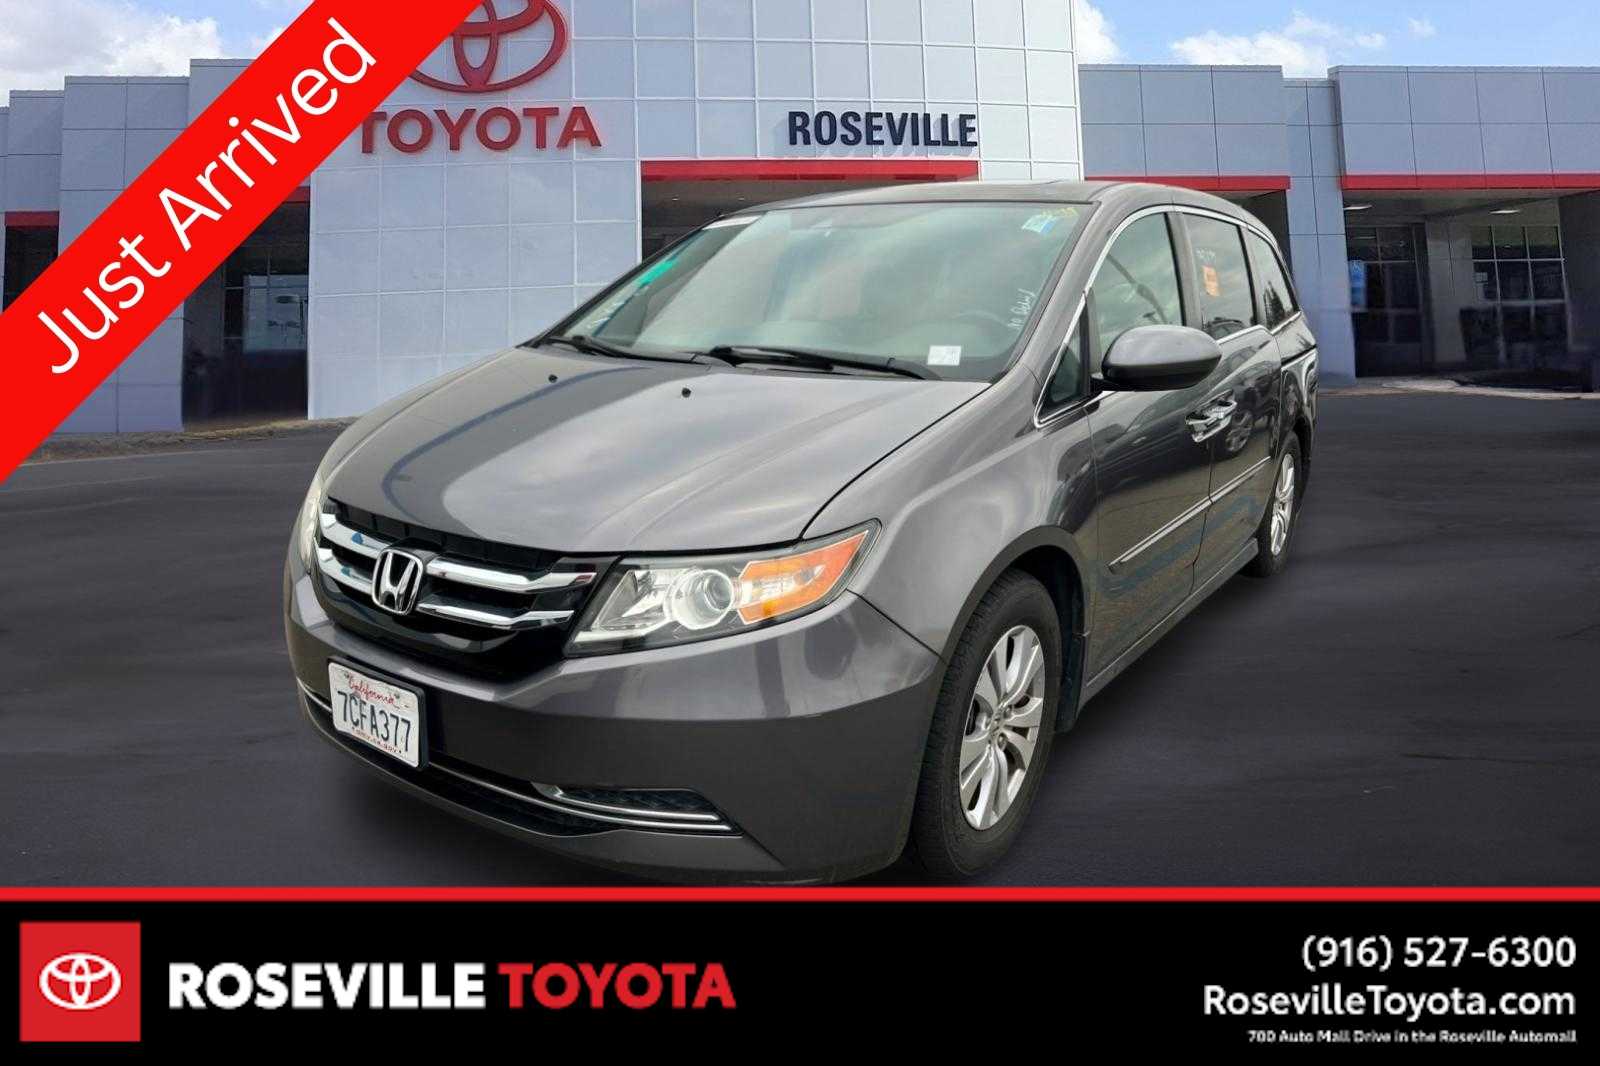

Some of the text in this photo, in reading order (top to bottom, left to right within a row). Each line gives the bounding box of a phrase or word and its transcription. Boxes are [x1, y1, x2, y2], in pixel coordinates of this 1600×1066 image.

[361, 106, 602, 154] TOYOTA
[788, 110, 978, 147] ROSEVILLE
[337, 690, 412, 752] 7CFA377
